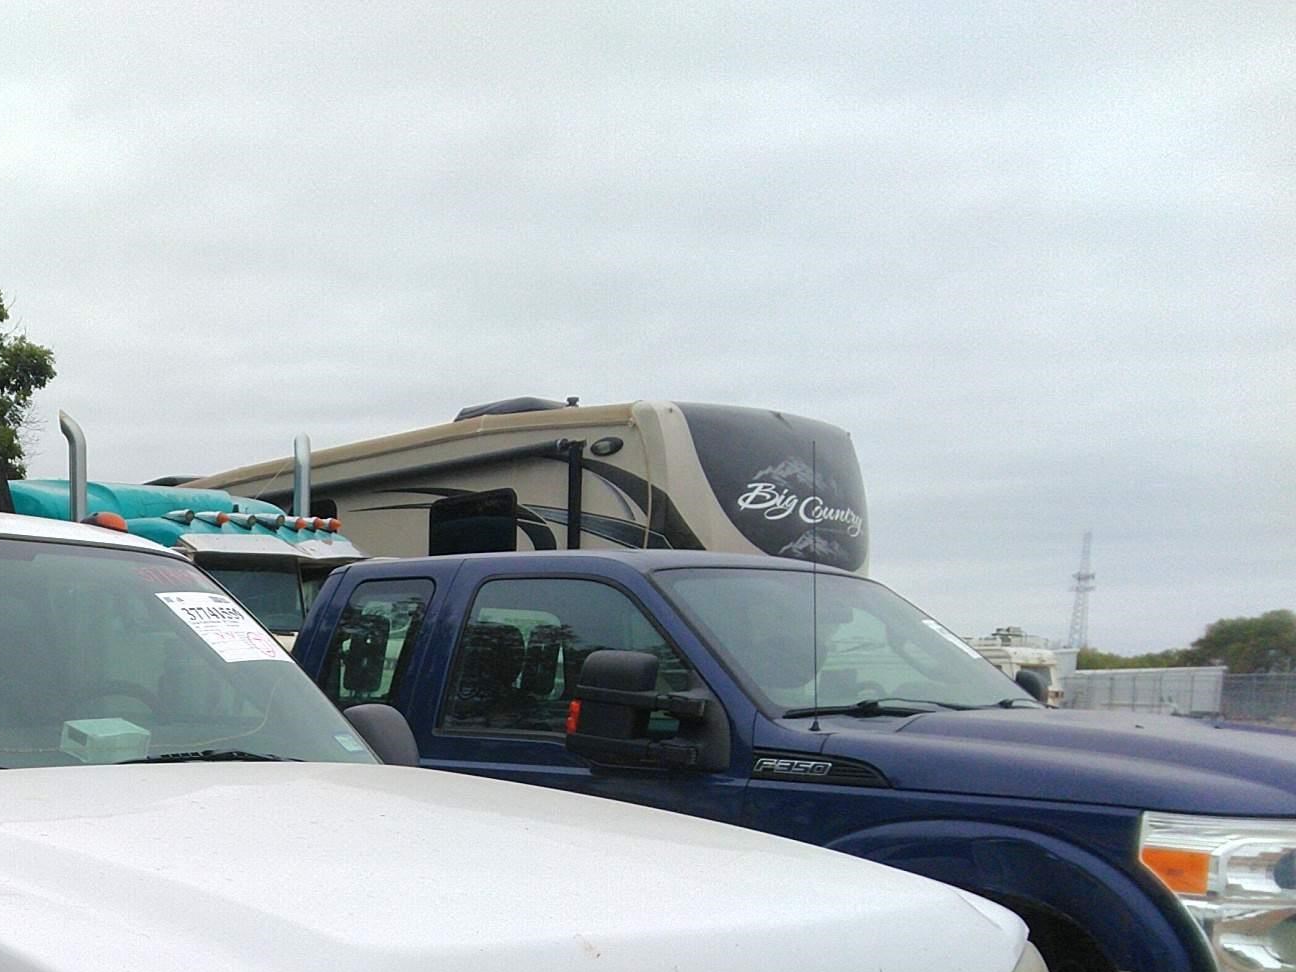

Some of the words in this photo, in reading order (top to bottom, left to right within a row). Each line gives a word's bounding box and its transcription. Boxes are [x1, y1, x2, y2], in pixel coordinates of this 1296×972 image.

[737, 483, 799, 520] Big
[799, 496, 864, 537] Country
[753, 758, 833, 775] F350
